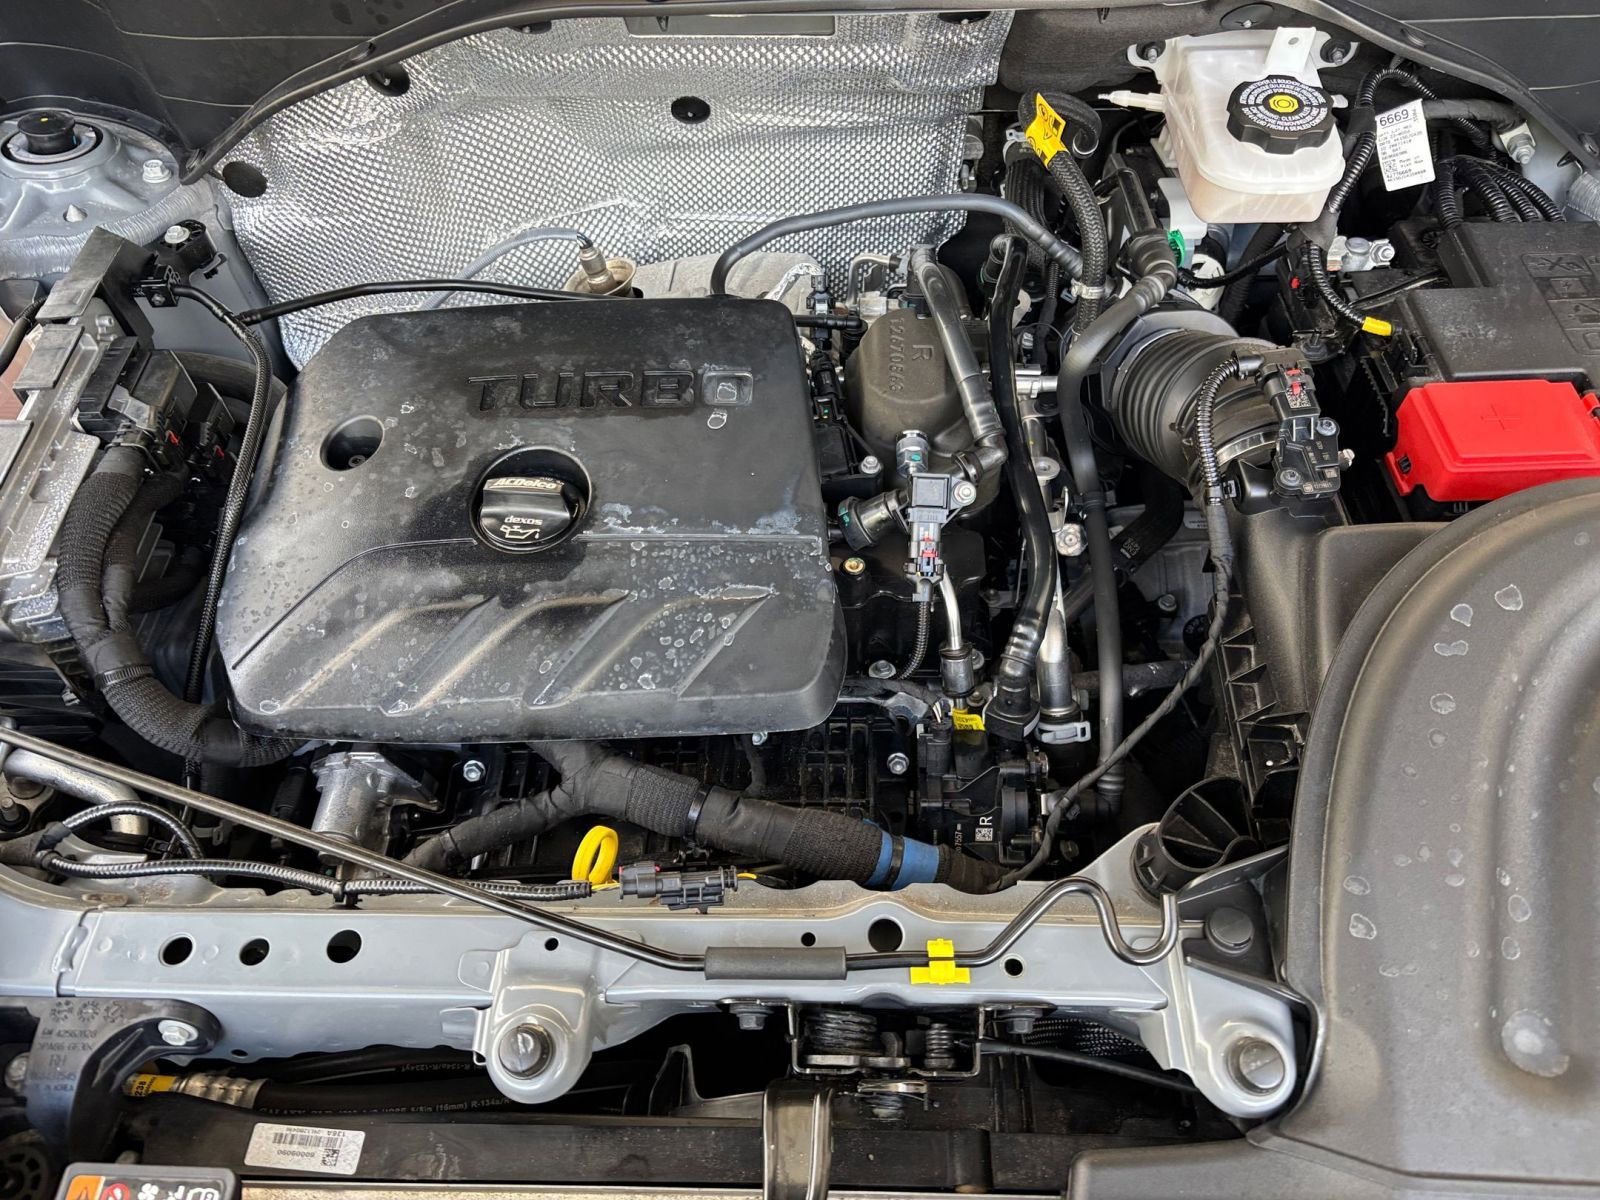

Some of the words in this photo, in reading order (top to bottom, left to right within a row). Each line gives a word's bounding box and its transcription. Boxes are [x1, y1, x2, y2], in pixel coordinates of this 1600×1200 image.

[1379, 109, 1409, 127] 6669
[912, 344, 934, 361] R
[467, 370, 754, 412] TURBO
[493, 478, 557, 490] ACDelco
[504, 515, 544, 525] dexos
[979, 816, 993, 826] R
